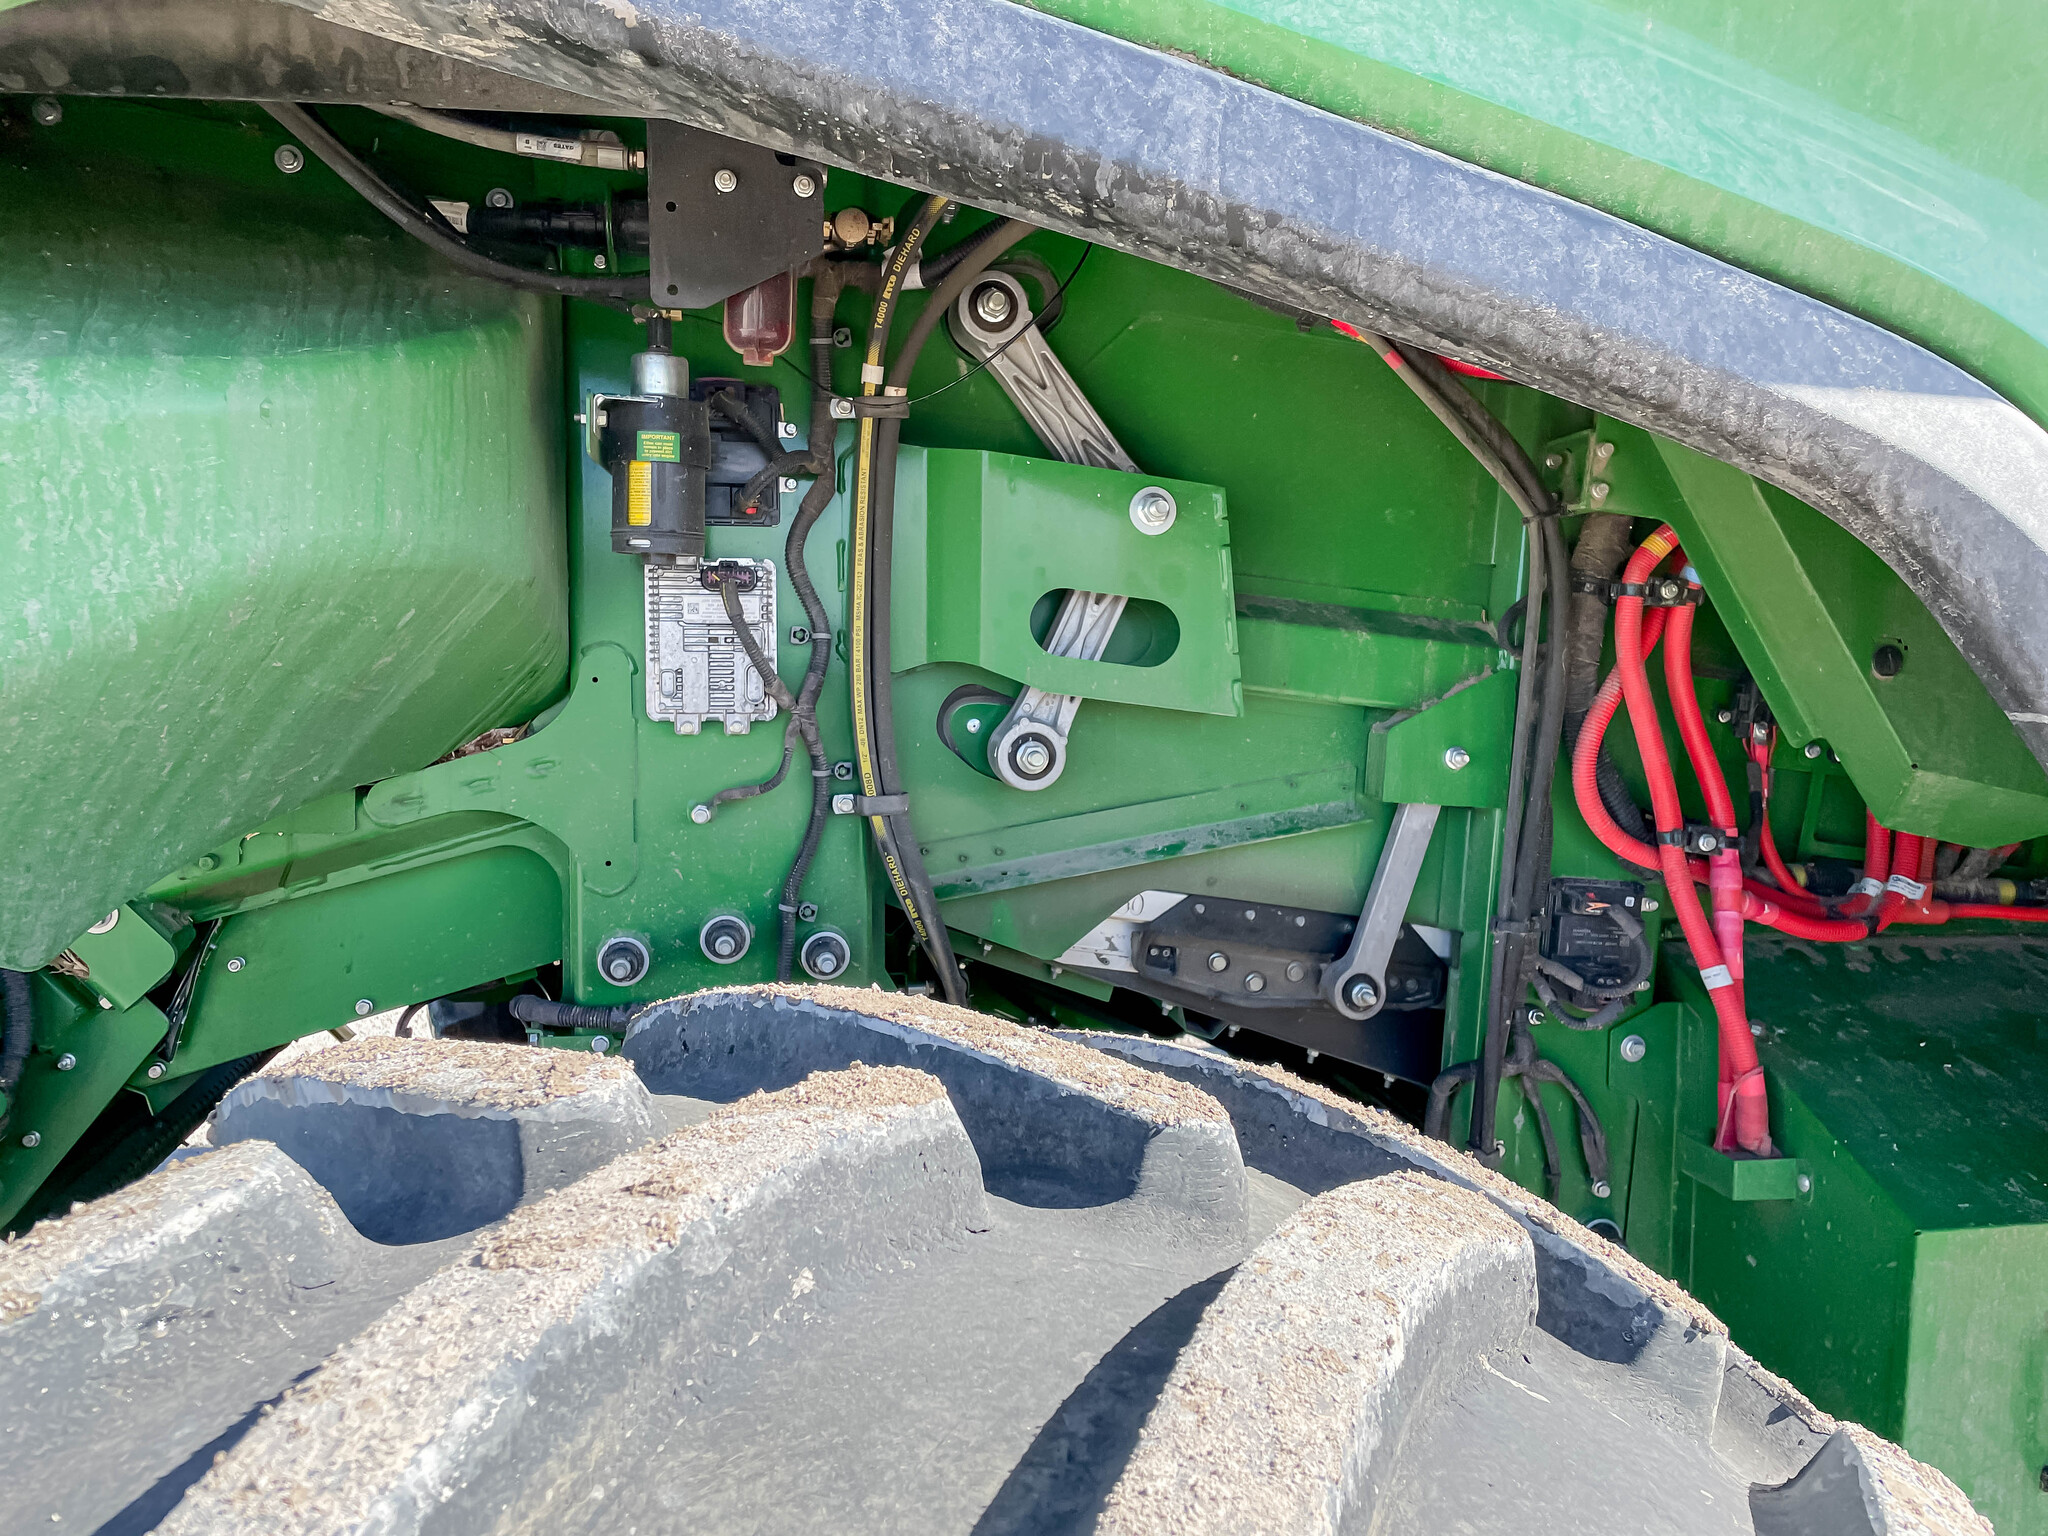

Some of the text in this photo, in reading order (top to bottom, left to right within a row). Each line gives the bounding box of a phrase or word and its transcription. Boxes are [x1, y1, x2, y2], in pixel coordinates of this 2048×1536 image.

[874, 301, 888, 329] T4000
[893, 228, 920, 272] DIEHARD
[858, 505, 866, 541] ABRASION
[886, 855, 908, 897] DIEHARD
[914, 920, 928, 941] T4000
